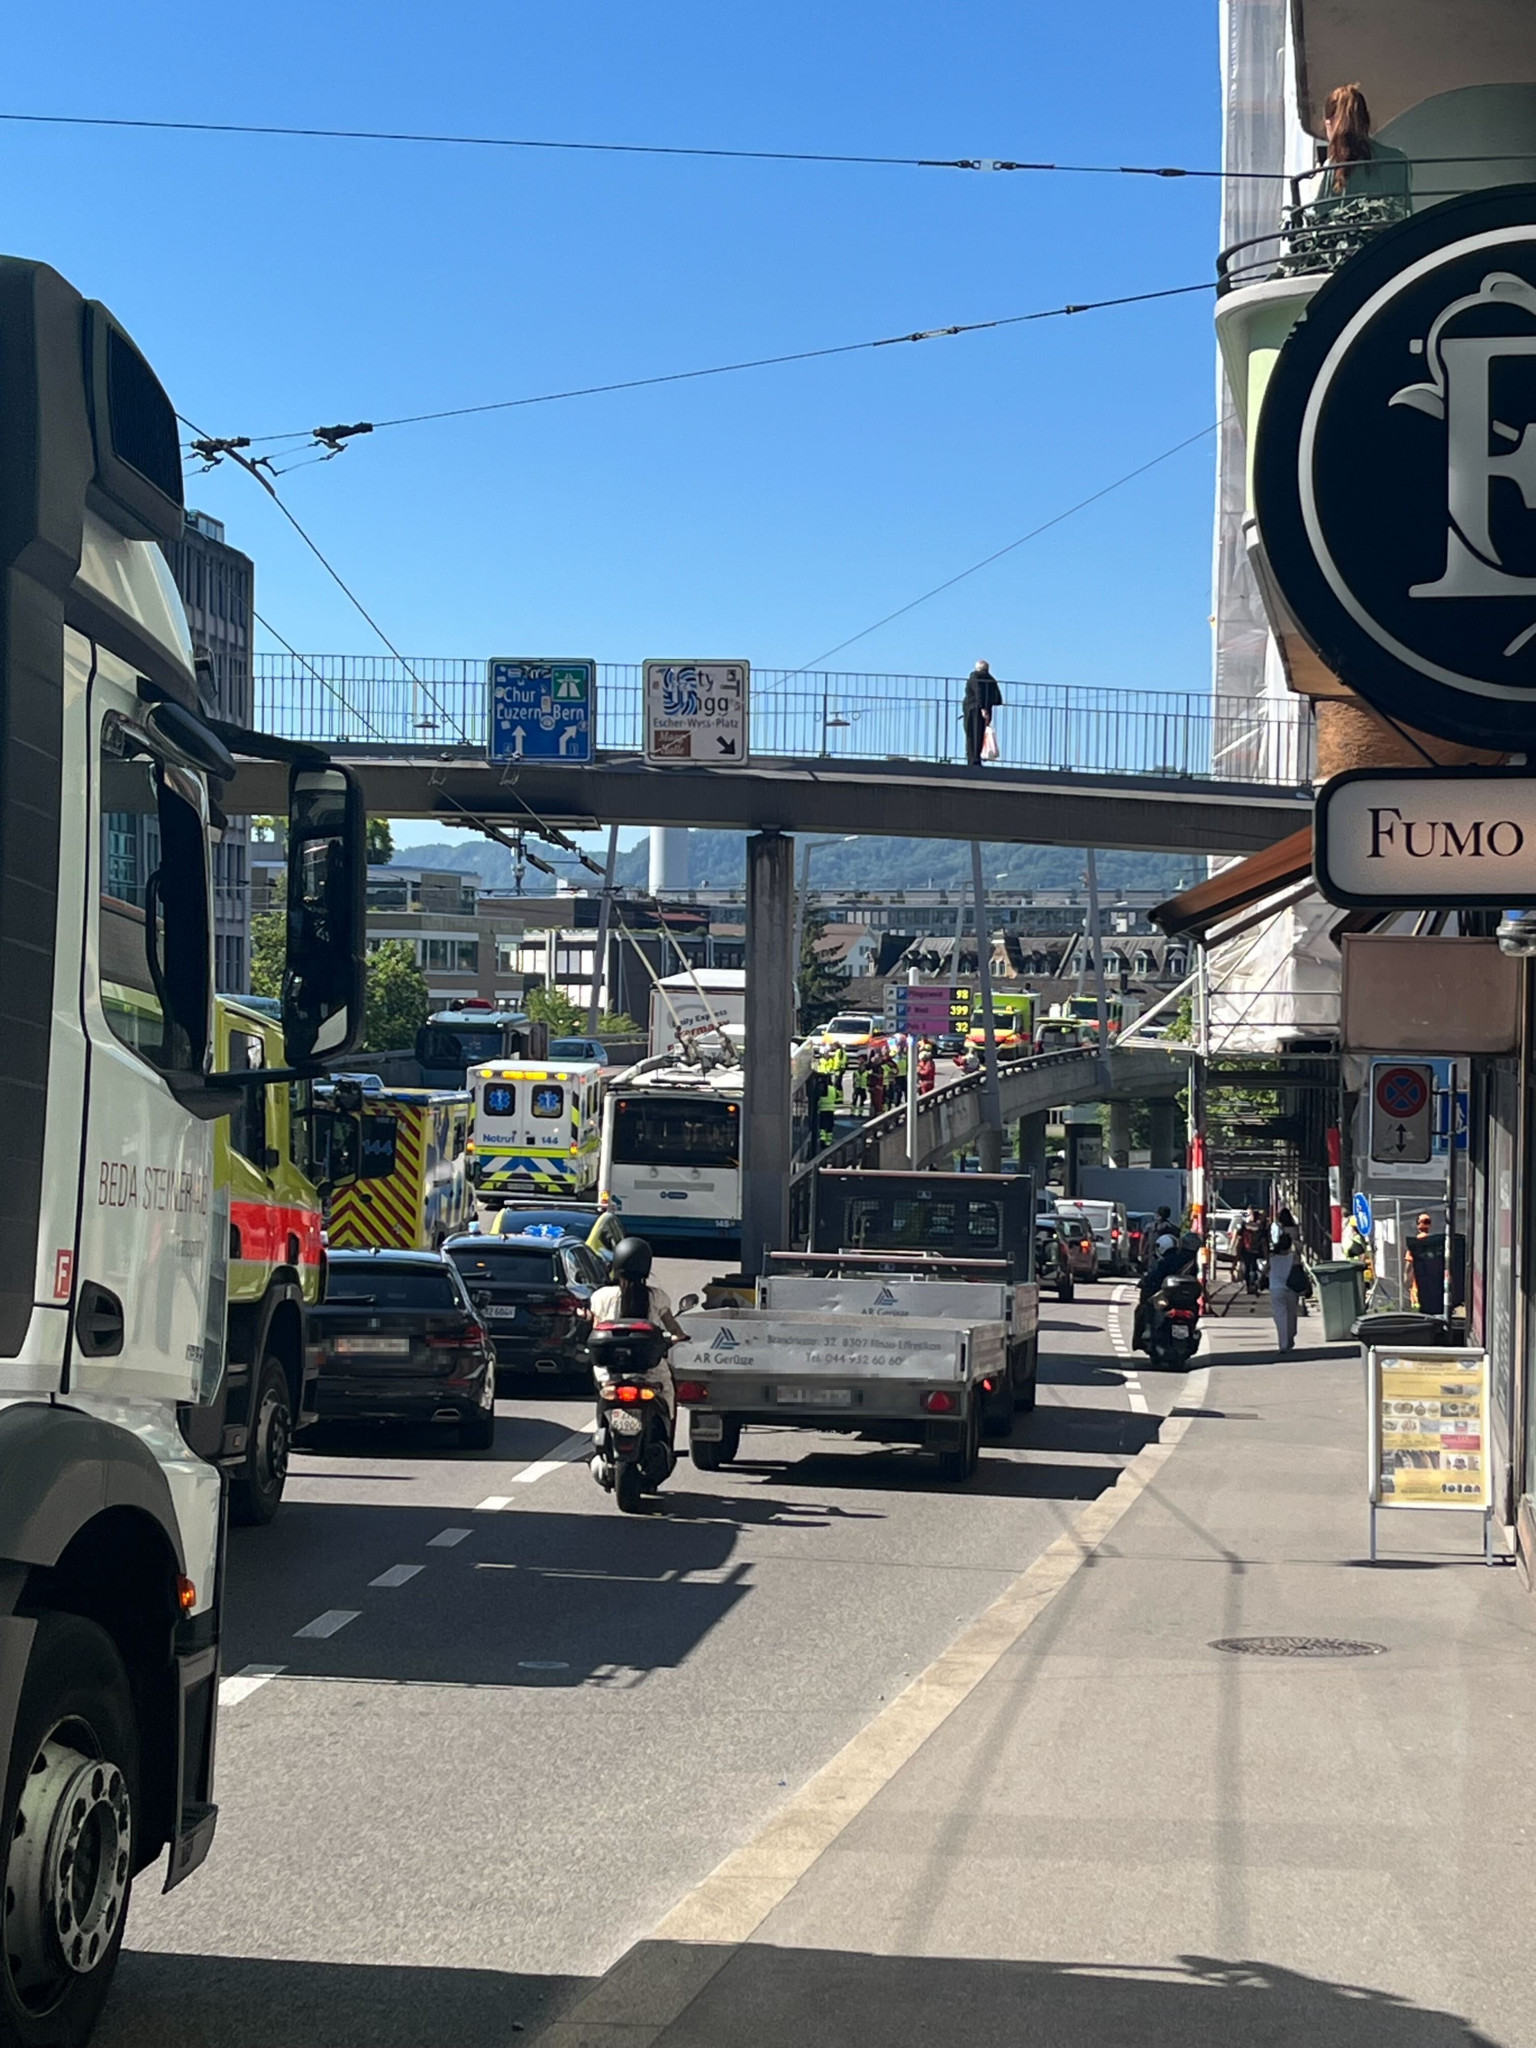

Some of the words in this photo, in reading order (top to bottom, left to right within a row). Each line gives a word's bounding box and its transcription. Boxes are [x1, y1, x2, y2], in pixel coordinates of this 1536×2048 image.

[504, 687, 536, 702] Chur
[497, 705, 541, 720] Luzern
[553, 704, 584, 720] Bern
[653, 718, 739, 728] Escher-Wyss-Platz
[1366, 807, 1524, 858] FUMO
[956, 989, 969, 999] 98
[949, 1005, 969, 1015] 399
[955, 1021, 969, 1032] 32
[482, 1133, 515, 1143] Notruf
[541, 1136, 559, 1144] 144
[362, 1139, 393, 1156] 144
[98, 1161, 137, 1208] BEDA
[824, 1337, 837, 1347] 32
[842, 1337, 868, 1348] 8307
[694, 1353, 711, 1364] AR
[825, 1354, 845, 1364] 044
[871, 1356, 886, 1366] 60
[888, 1356, 902, 1366] 60
